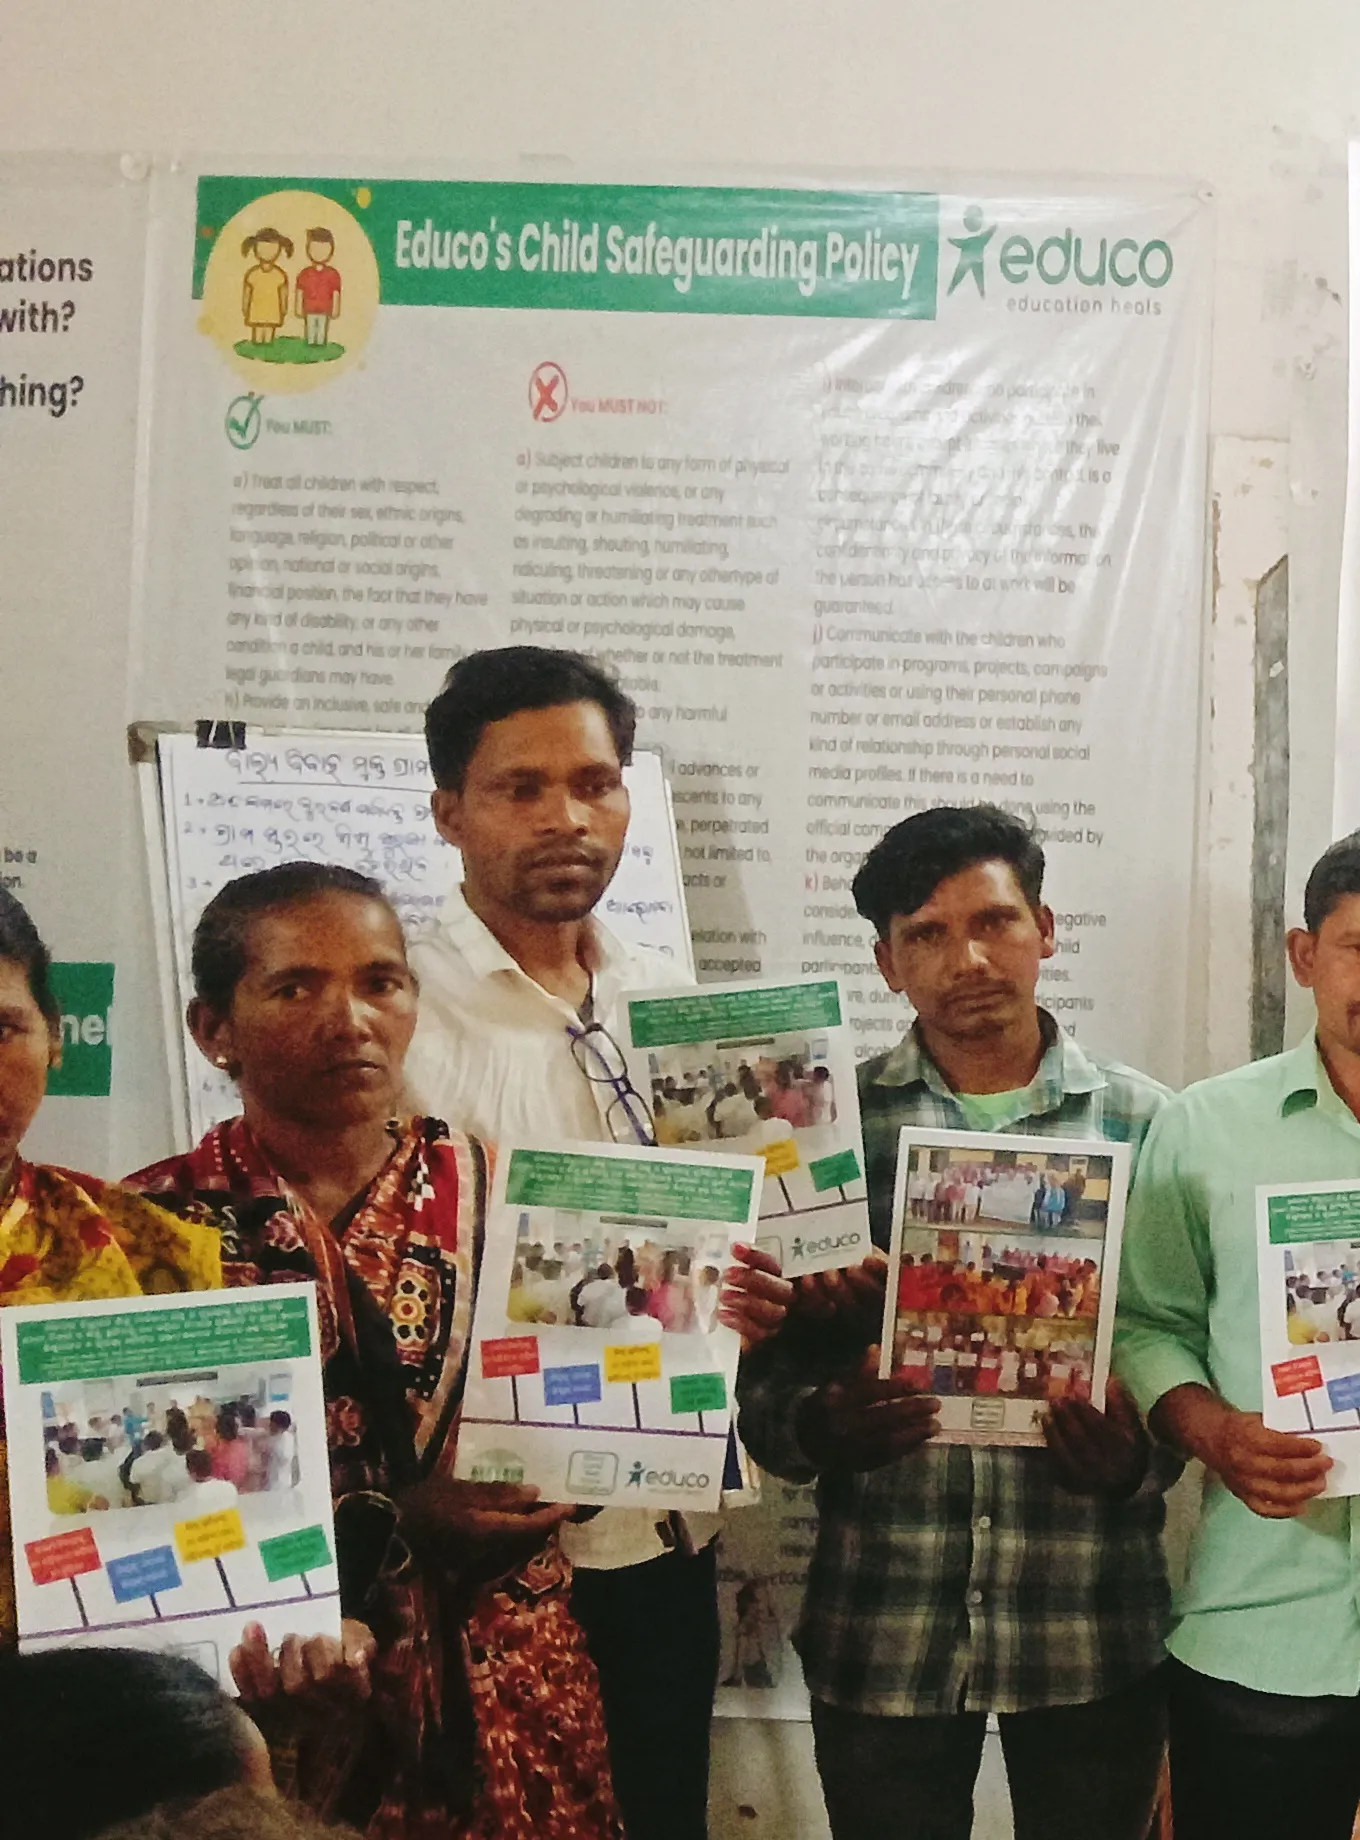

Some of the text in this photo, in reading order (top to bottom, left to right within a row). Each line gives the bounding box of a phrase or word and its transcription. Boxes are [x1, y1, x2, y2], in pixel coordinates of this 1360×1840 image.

[396, 216, 919, 300] Educo's Child Safeguarding Policy
[1000, 227, 1173, 288] educo
[1006, 296, 1162, 316] education heals
